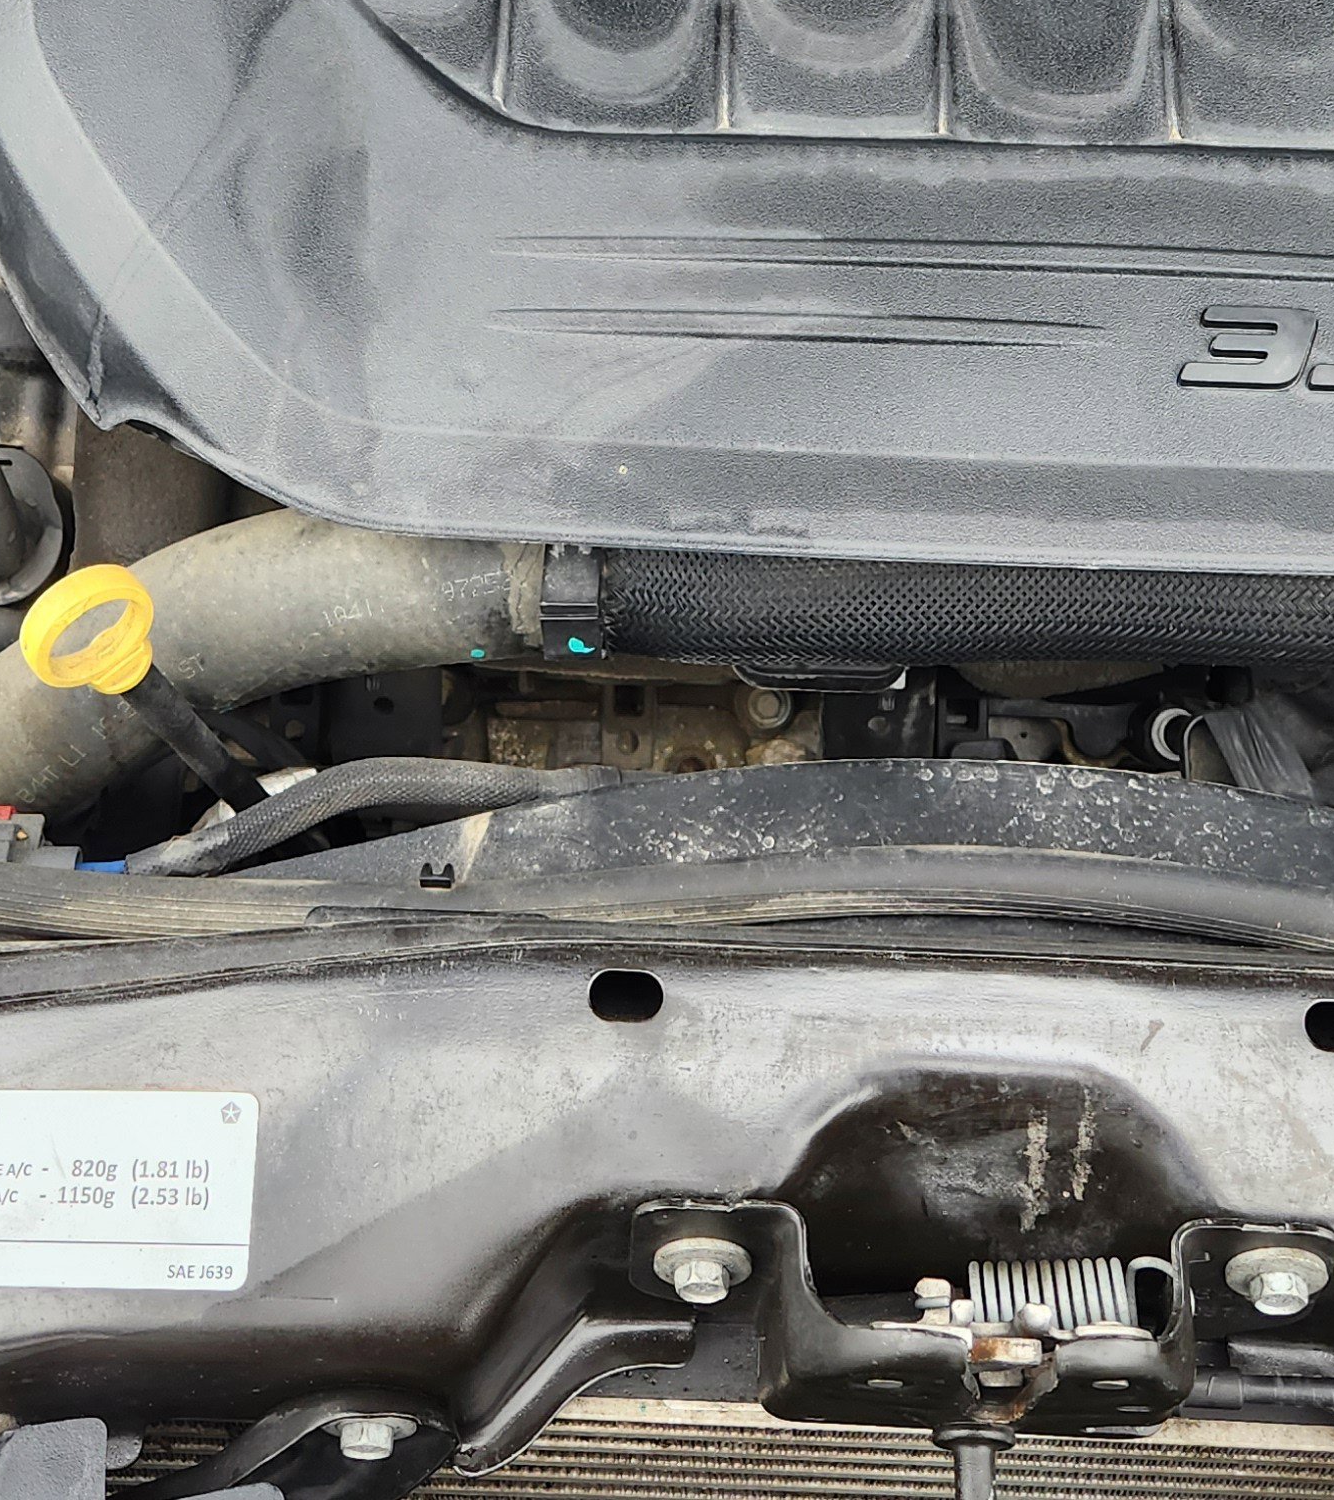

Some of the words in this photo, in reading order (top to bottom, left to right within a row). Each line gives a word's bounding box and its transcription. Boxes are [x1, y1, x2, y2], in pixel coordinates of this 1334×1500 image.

[6, 1161, 33, 1179] A/C
[71, 1159, 118, 1182] 820g
[132, 1159, 179, 1182] (1.81
[186, 1159, 210, 1183] lb)
[57, 1186, 115, 1209] 1150g
[131, 1186, 179, 1209] (2.53
[185, 1186, 210, 1210] lb)
[167, 1265, 195, 1279] SAE
[199, 1266, 233, 1279] J639
